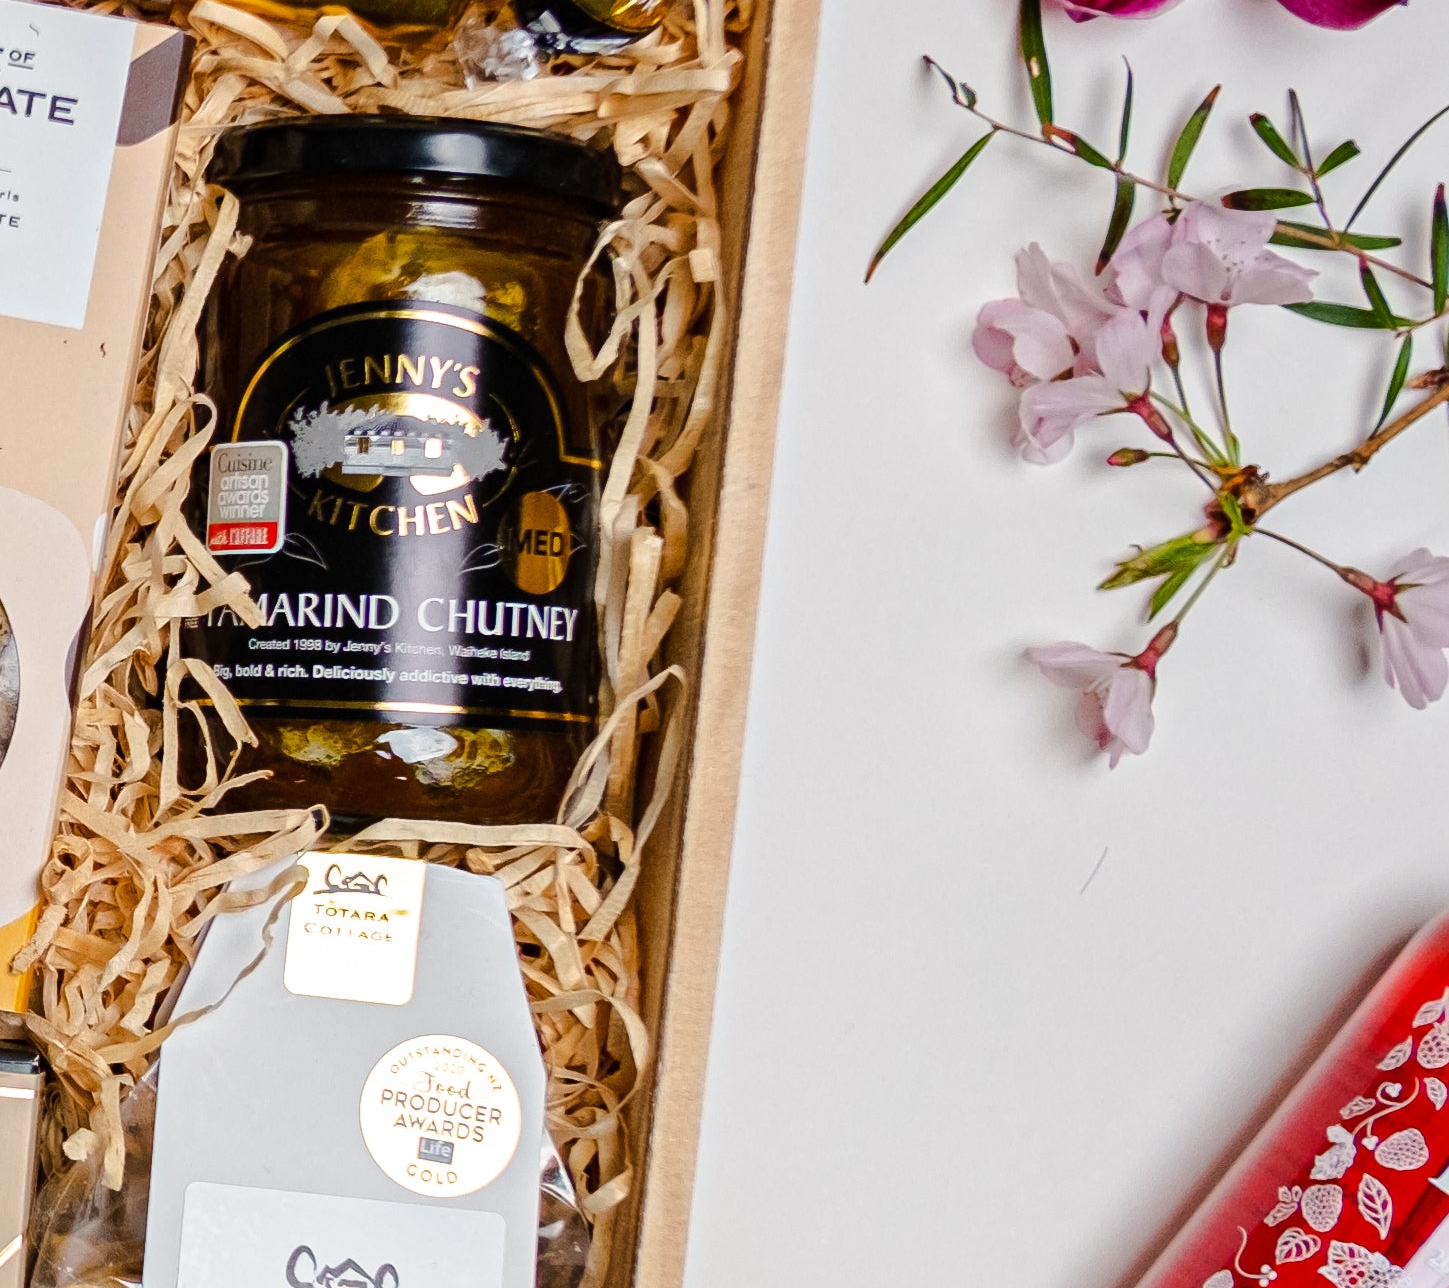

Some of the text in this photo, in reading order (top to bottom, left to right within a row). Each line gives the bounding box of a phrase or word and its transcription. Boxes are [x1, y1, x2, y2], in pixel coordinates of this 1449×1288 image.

[8, 49, 35, 65] OF
[326, 353, 480, 398] JENNY'S
[217, 451, 273, 474] Cuisine
[220, 473, 269, 493] artisan
[218, 489, 269, 505] awards
[218, 503, 267, 519] winner
[308, 489, 480, 537] KITCHEN
[417, 597, 578, 642] CHUTNEY
[249, 637, 290, 651] Created
[325, 640, 340, 654] by
[235, 665, 262, 678] bold
[265, 665, 275, 678] &
[278, 665, 309, 679] rich.
[313, 666, 396, 683] Deliciously
[399, 670, 469, 685] addictive
[471, 673, 501, 687] with
[314, 903, 390, 923] TOTARA
[381, 1088, 502, 1125] PRODUCER
[393, 1114, 485, 1143] AWARDS
[407, 1164, 458, 1185] GOLD
